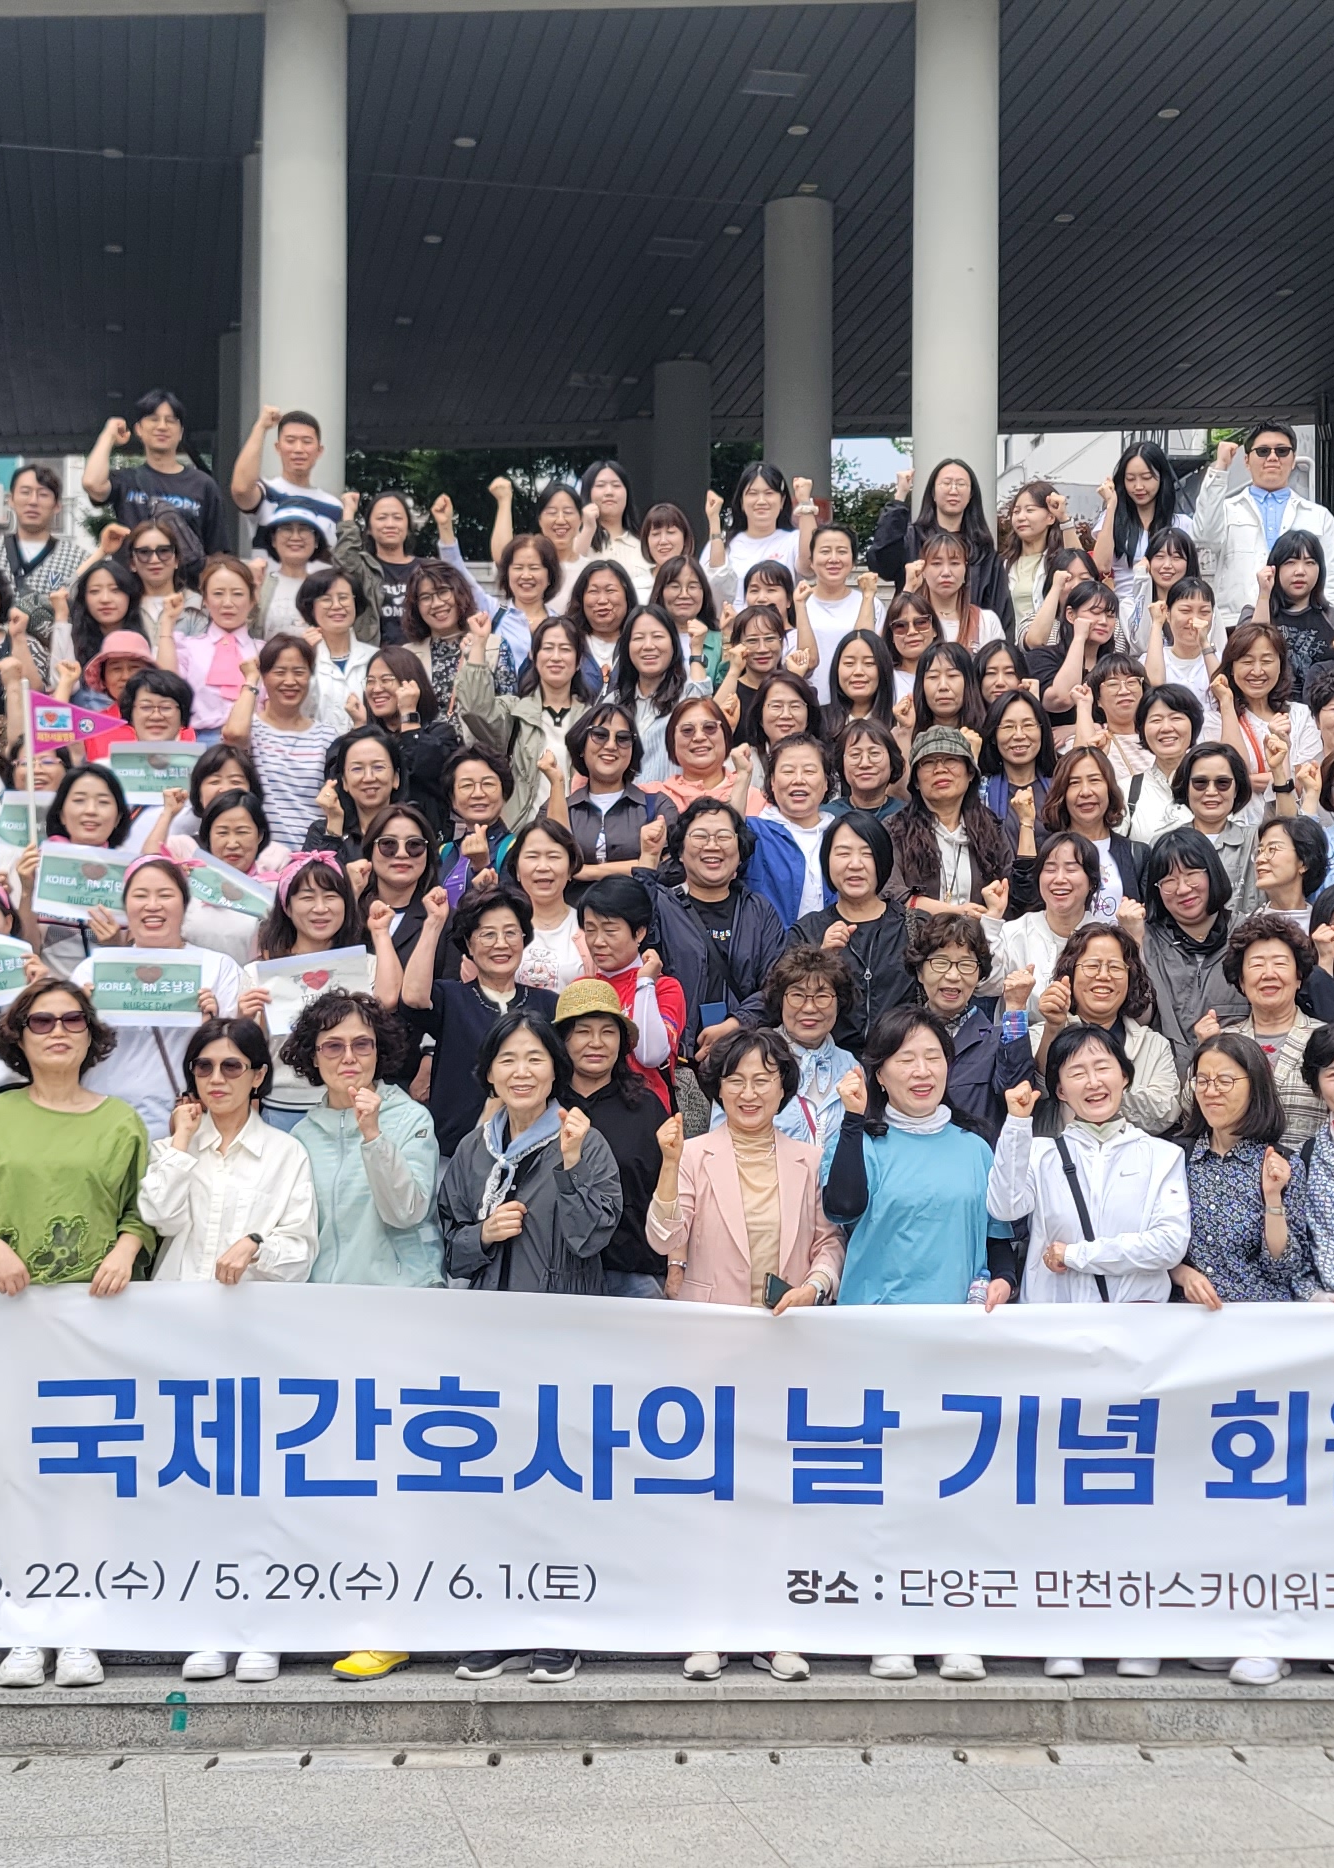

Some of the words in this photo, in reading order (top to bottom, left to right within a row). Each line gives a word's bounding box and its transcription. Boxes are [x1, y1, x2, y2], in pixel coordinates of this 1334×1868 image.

[45, 875, 78, 887] KOREA
[98, 981, 133, 992] KOREA
[142, 982, 157, 992] RN
[159, 981, 195, 993] 조남정
[31, 1376, 736, 1501] 국제간호사의
[786, 1387, 901, 1506] 날
[938, 1393, 1160, 1506] 기념
[24, 1560, 167, 1601] 22.(수)
[214, 1563, 250, 1601] 5.
[264, 1561, 400, 1602] 29.(수)
[447, 1563, 484, 1600] 6.
[498, 1561, 598, 1602] 1.(토)
[786, 1568, 859, 1605] 장소
[899, 1568, 1020, 1608] 단양군
